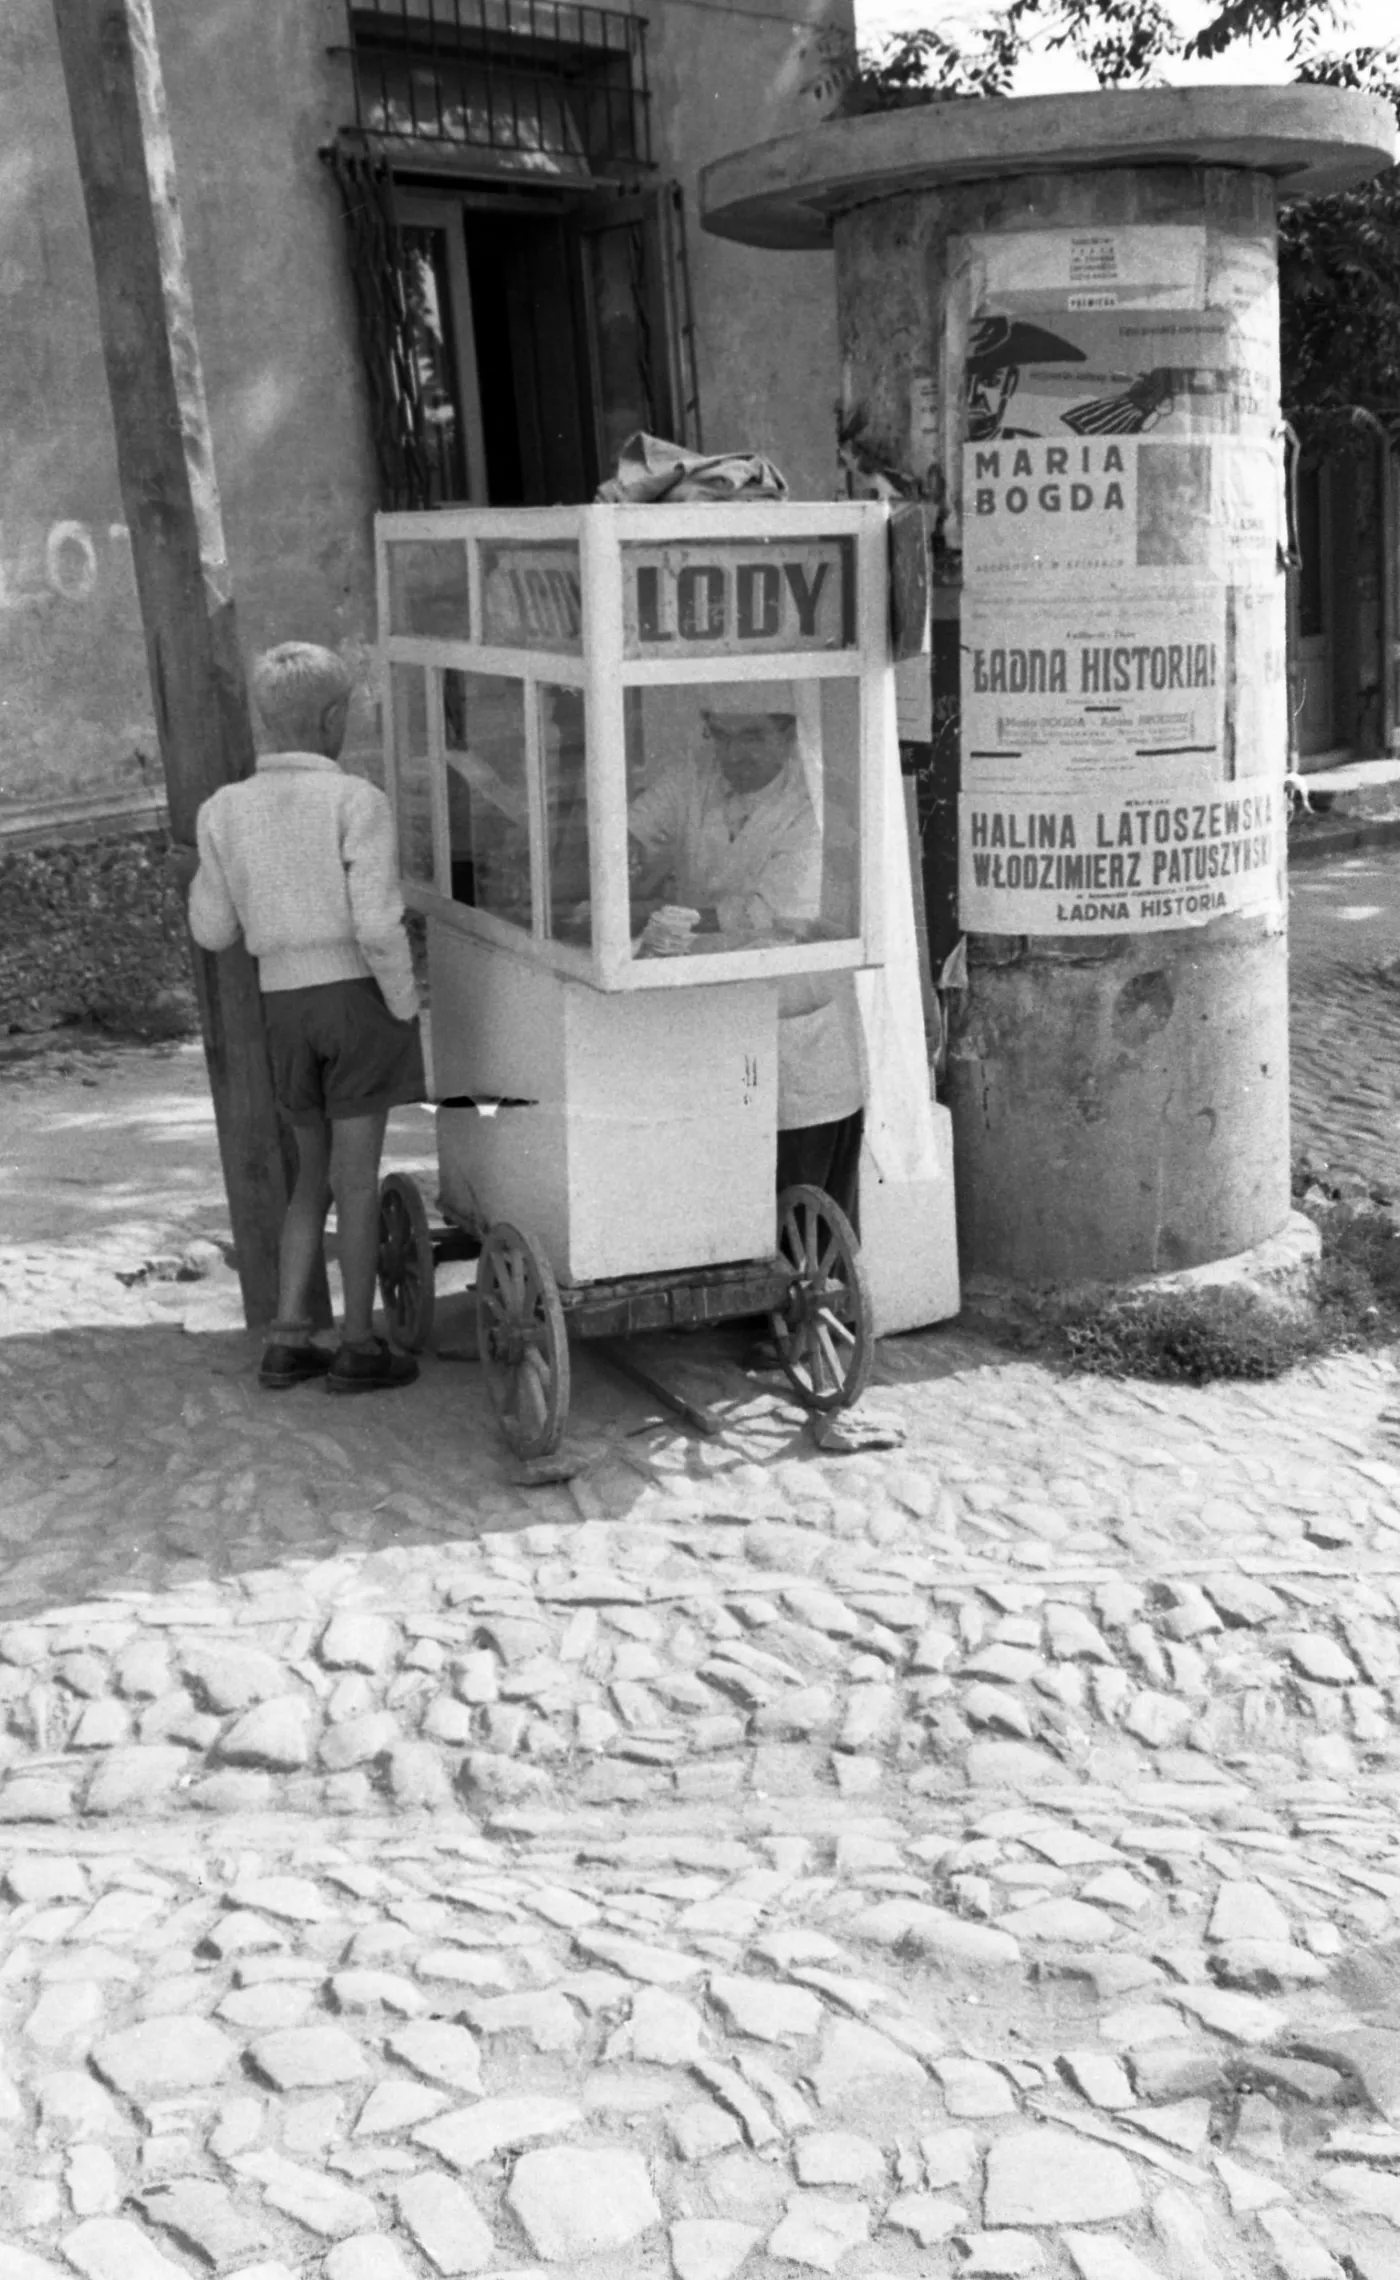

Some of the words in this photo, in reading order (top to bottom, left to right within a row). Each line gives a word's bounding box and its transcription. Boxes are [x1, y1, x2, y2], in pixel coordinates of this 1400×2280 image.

[974, 445, 1125, 479] MARIA
[974, 482, 1125, 515] BOGDA
[636, 562, 829, 642] LODY
[972, 648, 1067, 693] ŁADNA
[1080, 643, 1216, 692] HISTORIA!
[971, 812, 1075, 849] HALINA
[1096, 795, 1272, 847] LATOSZEWSKA
[973, 852, 1141, 889] WŁODZIMIERZ
[1056, 904, 1129, 922] ŁADNA
[1140, 891, 1227, 918] HISTORIA
